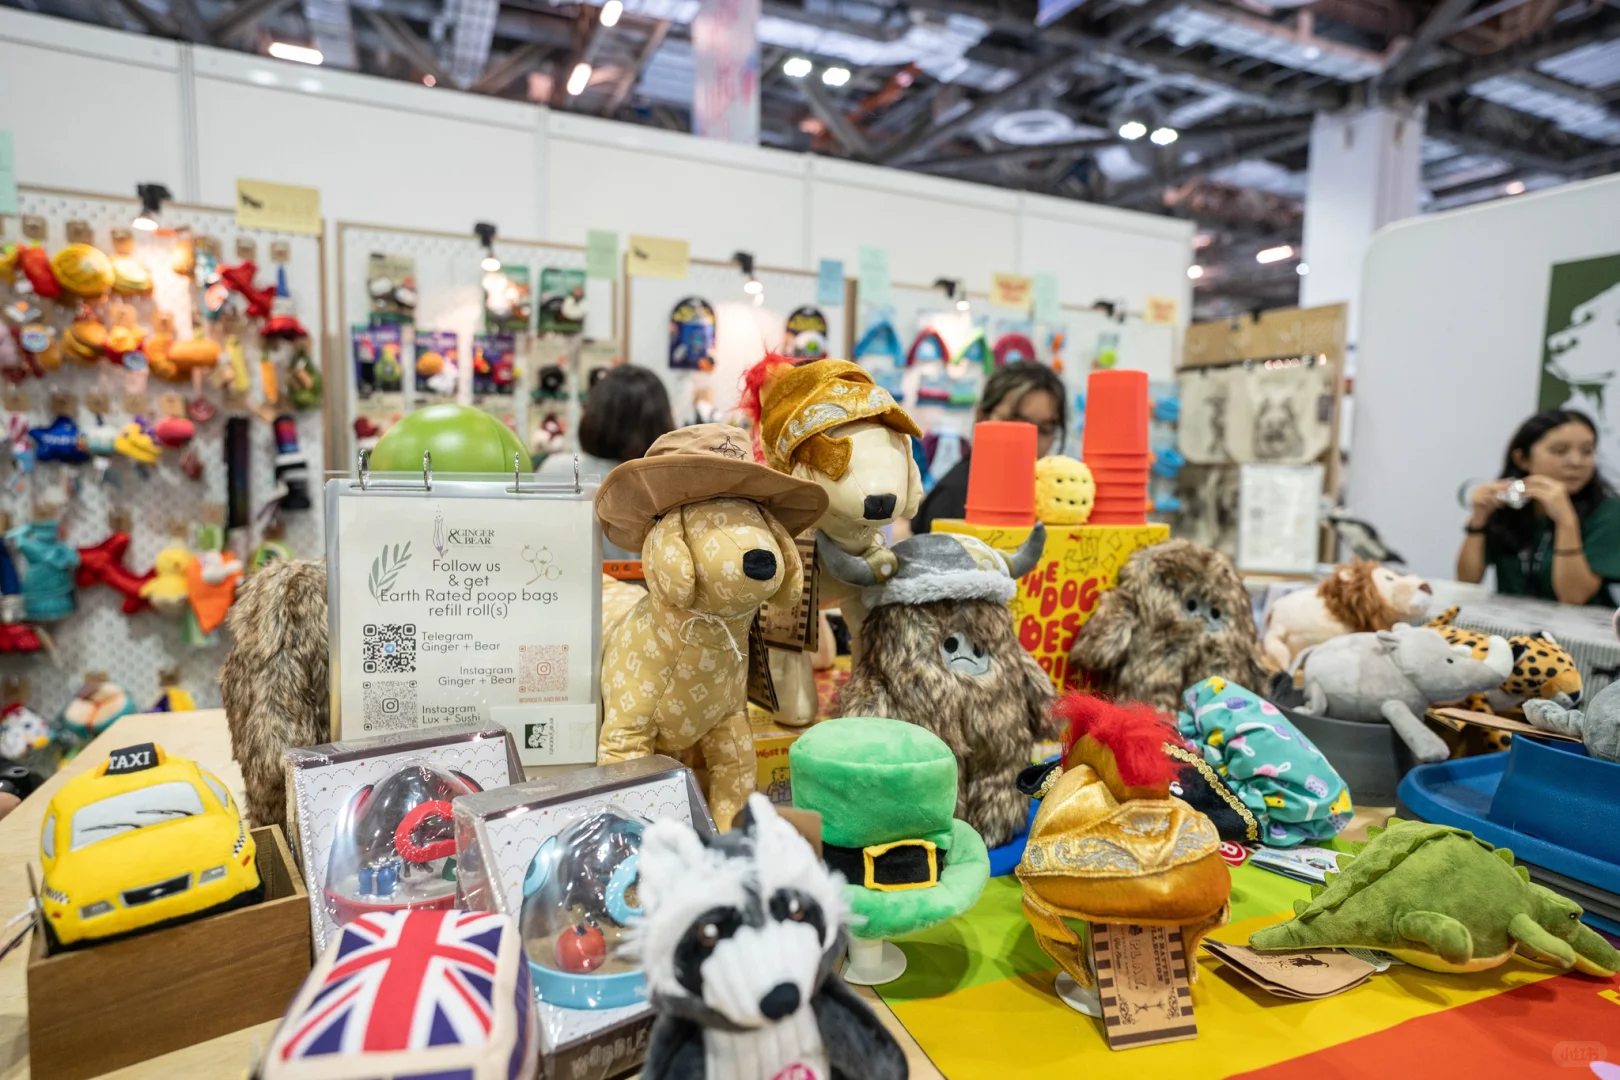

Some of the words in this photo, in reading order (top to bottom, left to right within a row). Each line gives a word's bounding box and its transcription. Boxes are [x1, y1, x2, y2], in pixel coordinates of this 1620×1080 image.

[456, 529, 495, 538] GINGER
[464, 537, 492, 545] BEAR
[432, 559, 482, 572] Follow
[486, 562, 501, 572] us
[448, 573, 459, 587] &
[463, 574, 490, 591] get
[380, 588, 420, 602] Earth
[425, 588, 472, 602] Rated
[477, 591, 517, 604] poop
[522, 587, 559, 604] bags
[429, 603, 462, 617] refill
[467, 602, 508, 619] roll(s)
[421, 631, 474, 644] Telegram
[1018, 612, 1082, 654] BES
[421, 642, 459, 653] Ginger
[463, 642, 471, 651] +
[474, 641, 500, 651] Bear
[460, 665, 514, 677] Instagram
[438, 676, 475, 687] Ginger
[479, 676, 487, 685] +
[490, 675, 516, 685] Bear
[422, 705, 476, 717] Instagram
[422, 714, 440, 725] Lux
[444, 715, 451, 723] +
[455, 713, 481, 723] Sushi
[109, 751, 151, 770] TAXI
[1151, 926, 1164, 982] LLECTION
